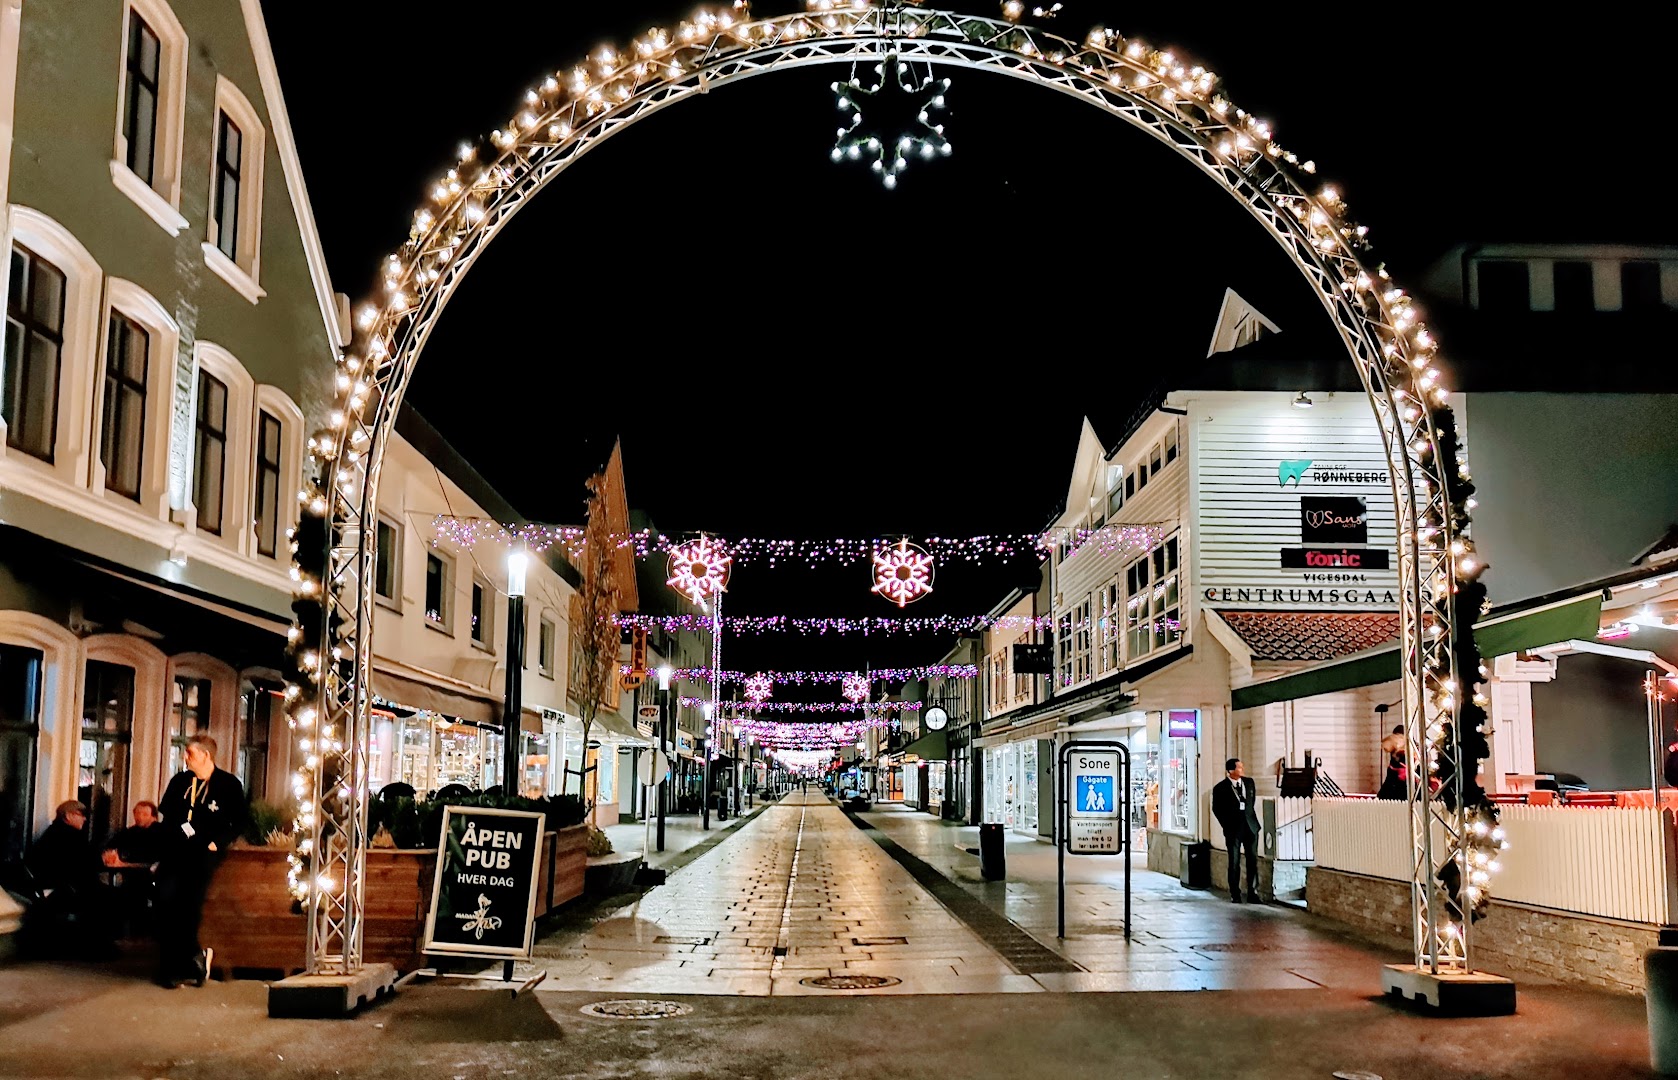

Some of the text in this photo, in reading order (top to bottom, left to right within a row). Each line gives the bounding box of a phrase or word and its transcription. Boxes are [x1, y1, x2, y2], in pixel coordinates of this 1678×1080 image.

[1313, 471, 1387, 483] RØNNEBERG
[1324, 510, 1362, 524] Sans
[1305, 549, 1361, 566] tonic
[1303, 573, 1367, 582] VIGESDAL
[624, 676, 640, 684] FILM
[1079, 757, 1111, 769] Sone
[1082, 775, 1107, 785] Gågate
[460, 822, 522, 849] ÅPEN
[465, 849, 511, 870] PUB
[457, 873, 514, 887] HVER DAG
